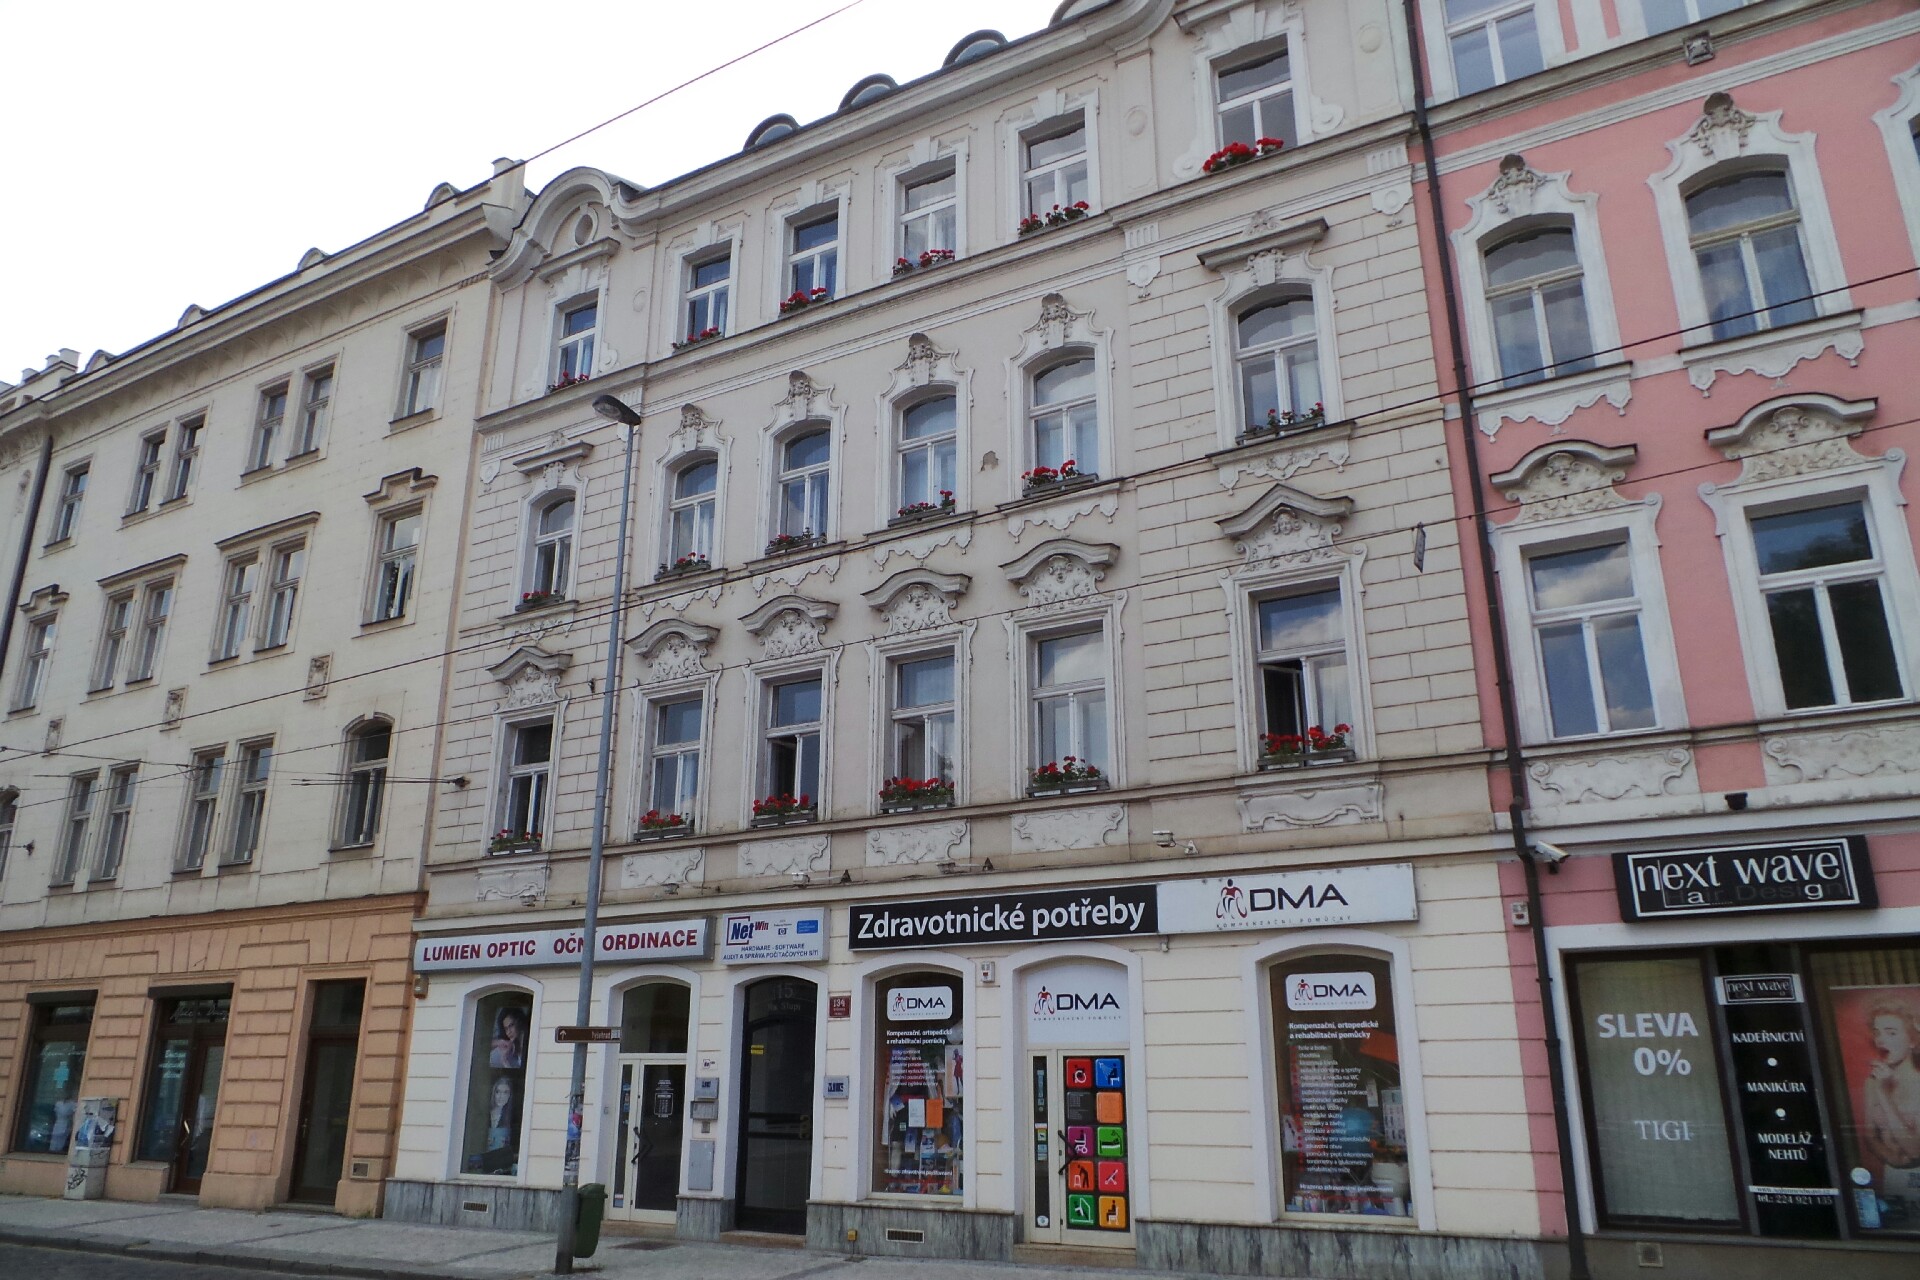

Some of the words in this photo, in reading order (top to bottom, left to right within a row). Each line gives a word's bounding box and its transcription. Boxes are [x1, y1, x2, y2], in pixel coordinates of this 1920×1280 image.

[1637, 855, 1720, 892] next
[1733, 851, 1840, 884] wave
[1249, 883, 1348, 912] DMA
[858, 902, 1025, 939] Zdravotnické
[1032, 895, 1145, 935] potřeby
[423, 943, 481, 961] LUMIEN
[487, 940, 536, 958] OPTIC
[553, 932, 585, 954] OČN
[602, 930, 697, 951] ORDINACE
[775, 943, 805, 951] SOFTWARE
[1313, 984, 1367, 997] DMA
[907, 997, 945, 1009] DMA
[1056, 992, 1120, 1010] DMA
[1597, 1012, 1699, 1038] SLEVA
[1732, 1029, 1805, 1043] KADEŘNICTVÍ
[1634, 1047, 1691, 1075] 0%
[1747, 1079, 1806, 1092] MANIKÚRA
[1634, 1120, 1691, 1141] TIGI
[1757, 1131, 1813, 1145] MODELÁŽ
[1768, 1147, 1808, 1161] NEHTŮ
